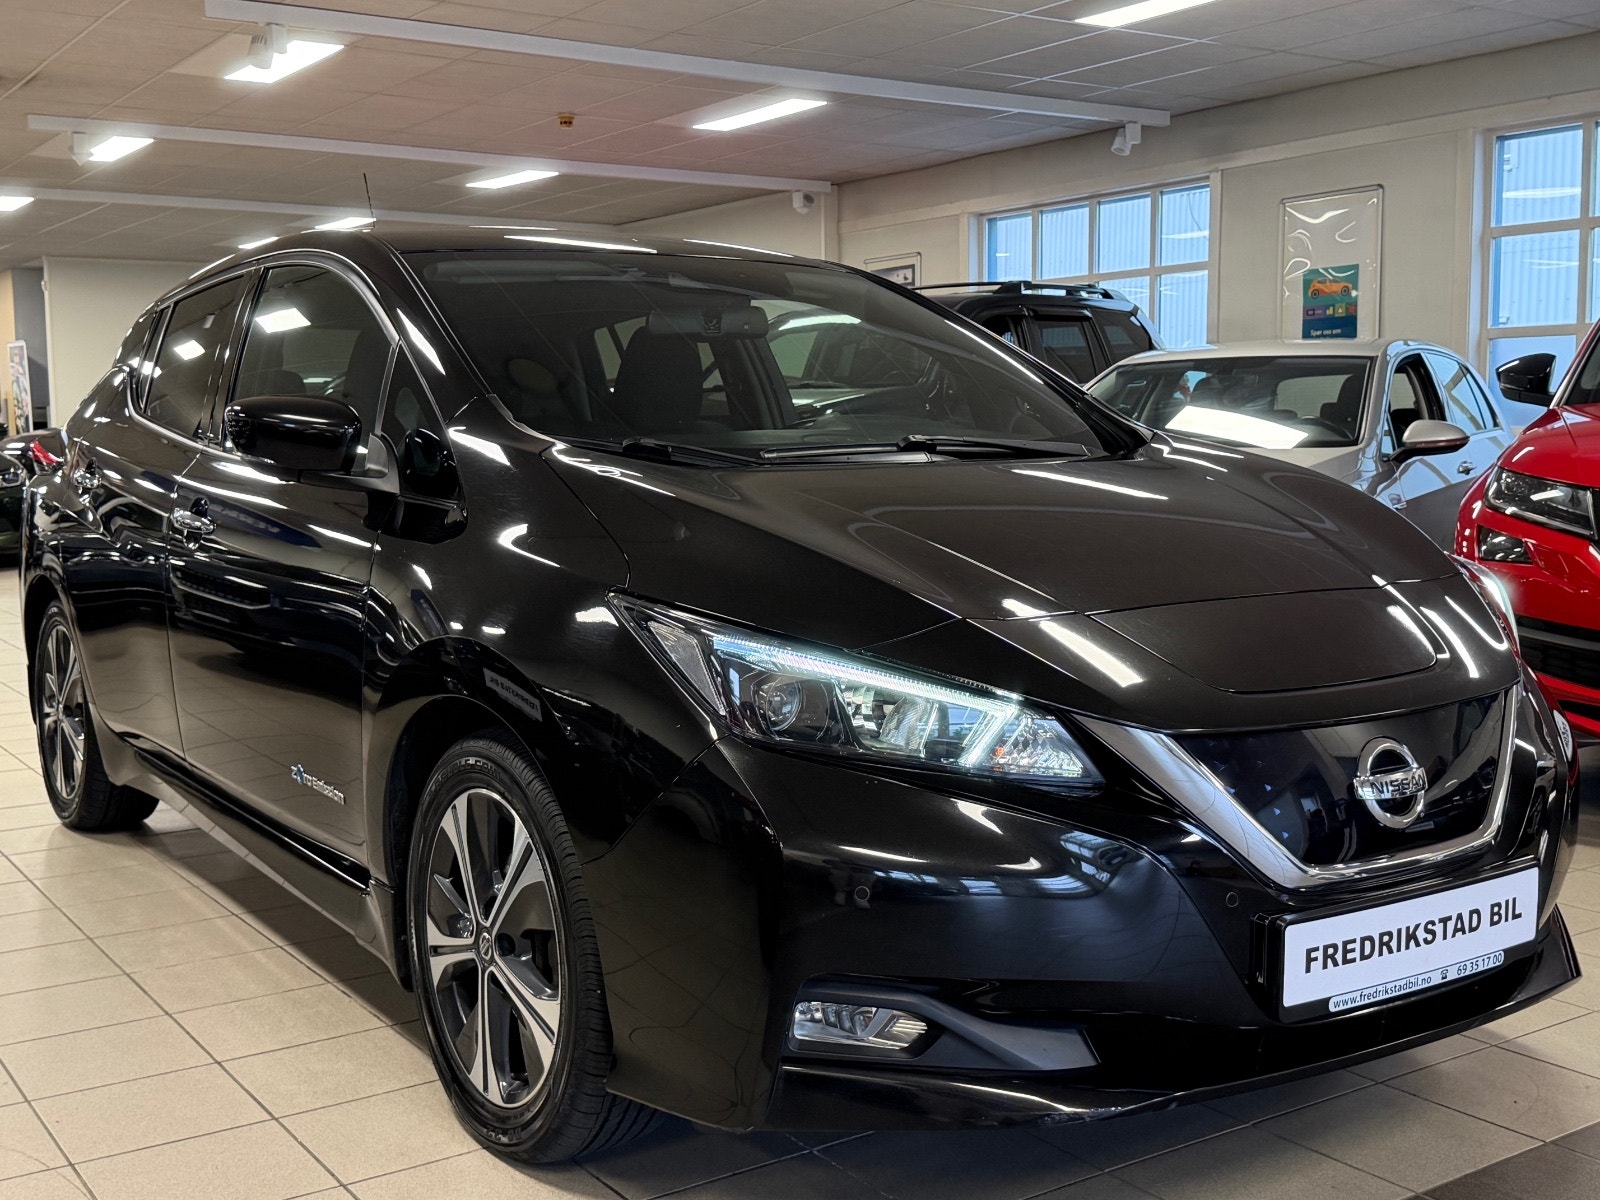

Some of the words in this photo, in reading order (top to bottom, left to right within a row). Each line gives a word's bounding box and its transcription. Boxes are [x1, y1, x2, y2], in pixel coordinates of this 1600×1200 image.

[1369, 773, 1426, 795] NISSAN
[1304, 907, 1482, 974] FREDRIKSTAD
[1488, 896, 1523, 928] BIL
[1333, 974, 1432, 1009] www.fredrikstadbil.no
[1456, 963, 1468, 976] 69
[1469, 959, 1479, 972] 35
[1481, 956, 1491, 968] 17
[1492, 952, 1502, 965] 00
